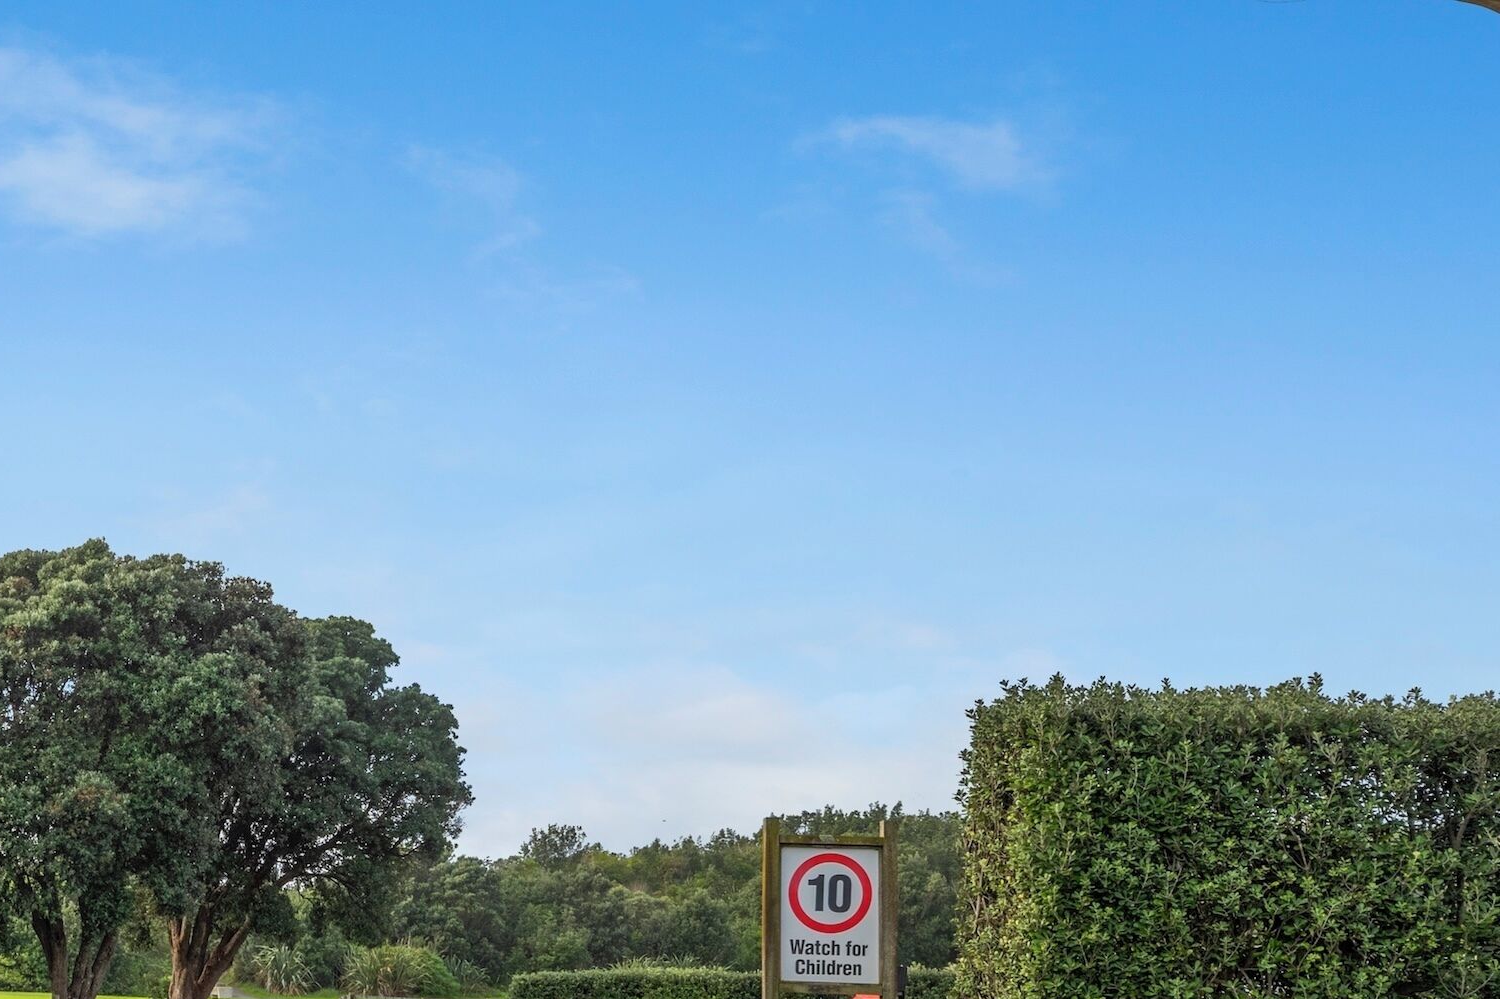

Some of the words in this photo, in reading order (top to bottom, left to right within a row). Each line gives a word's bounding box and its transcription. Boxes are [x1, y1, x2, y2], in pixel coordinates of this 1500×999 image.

[808, 874, 852, 913] 10
[790, 939, 841, 956] Watch
[845, 940, 868, 957] for
[795, 959, 862, 976] Children
